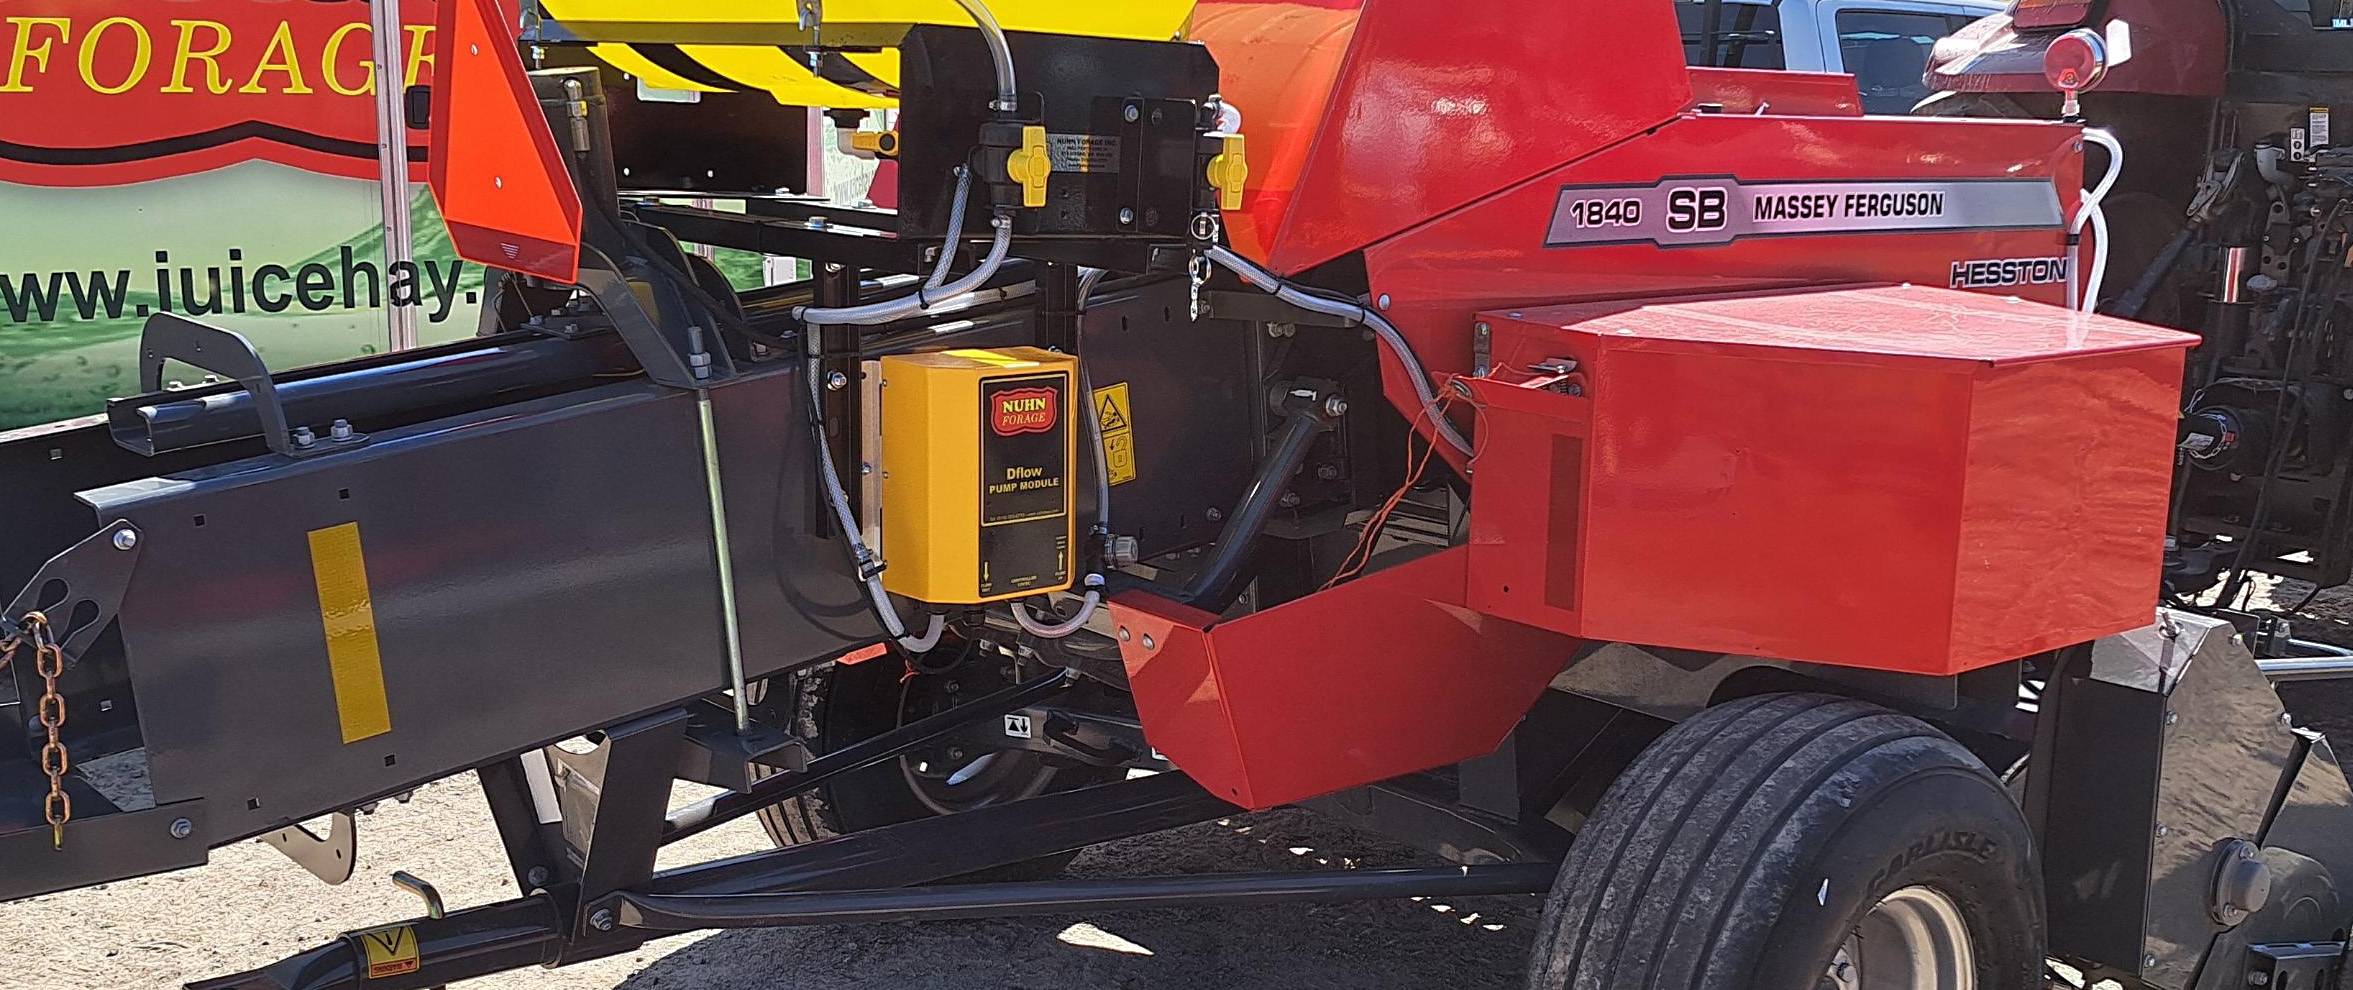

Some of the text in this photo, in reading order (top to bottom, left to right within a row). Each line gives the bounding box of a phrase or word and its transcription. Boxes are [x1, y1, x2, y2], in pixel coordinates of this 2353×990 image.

[1571, 188, 1944, 232] 1840 SB MASSEY FERGUSON
[1950, 257, 2068, 288] HESSTON
[1002, 397, 1046, 413] NUHN
[1002, 412, 1046, 426] FORAGE
[1006, 467, 1043, 481] Dflow
[989, 477, 1060, 494] PUMP MODULE
[1866, 829, 1999, 900] CARLISLE
